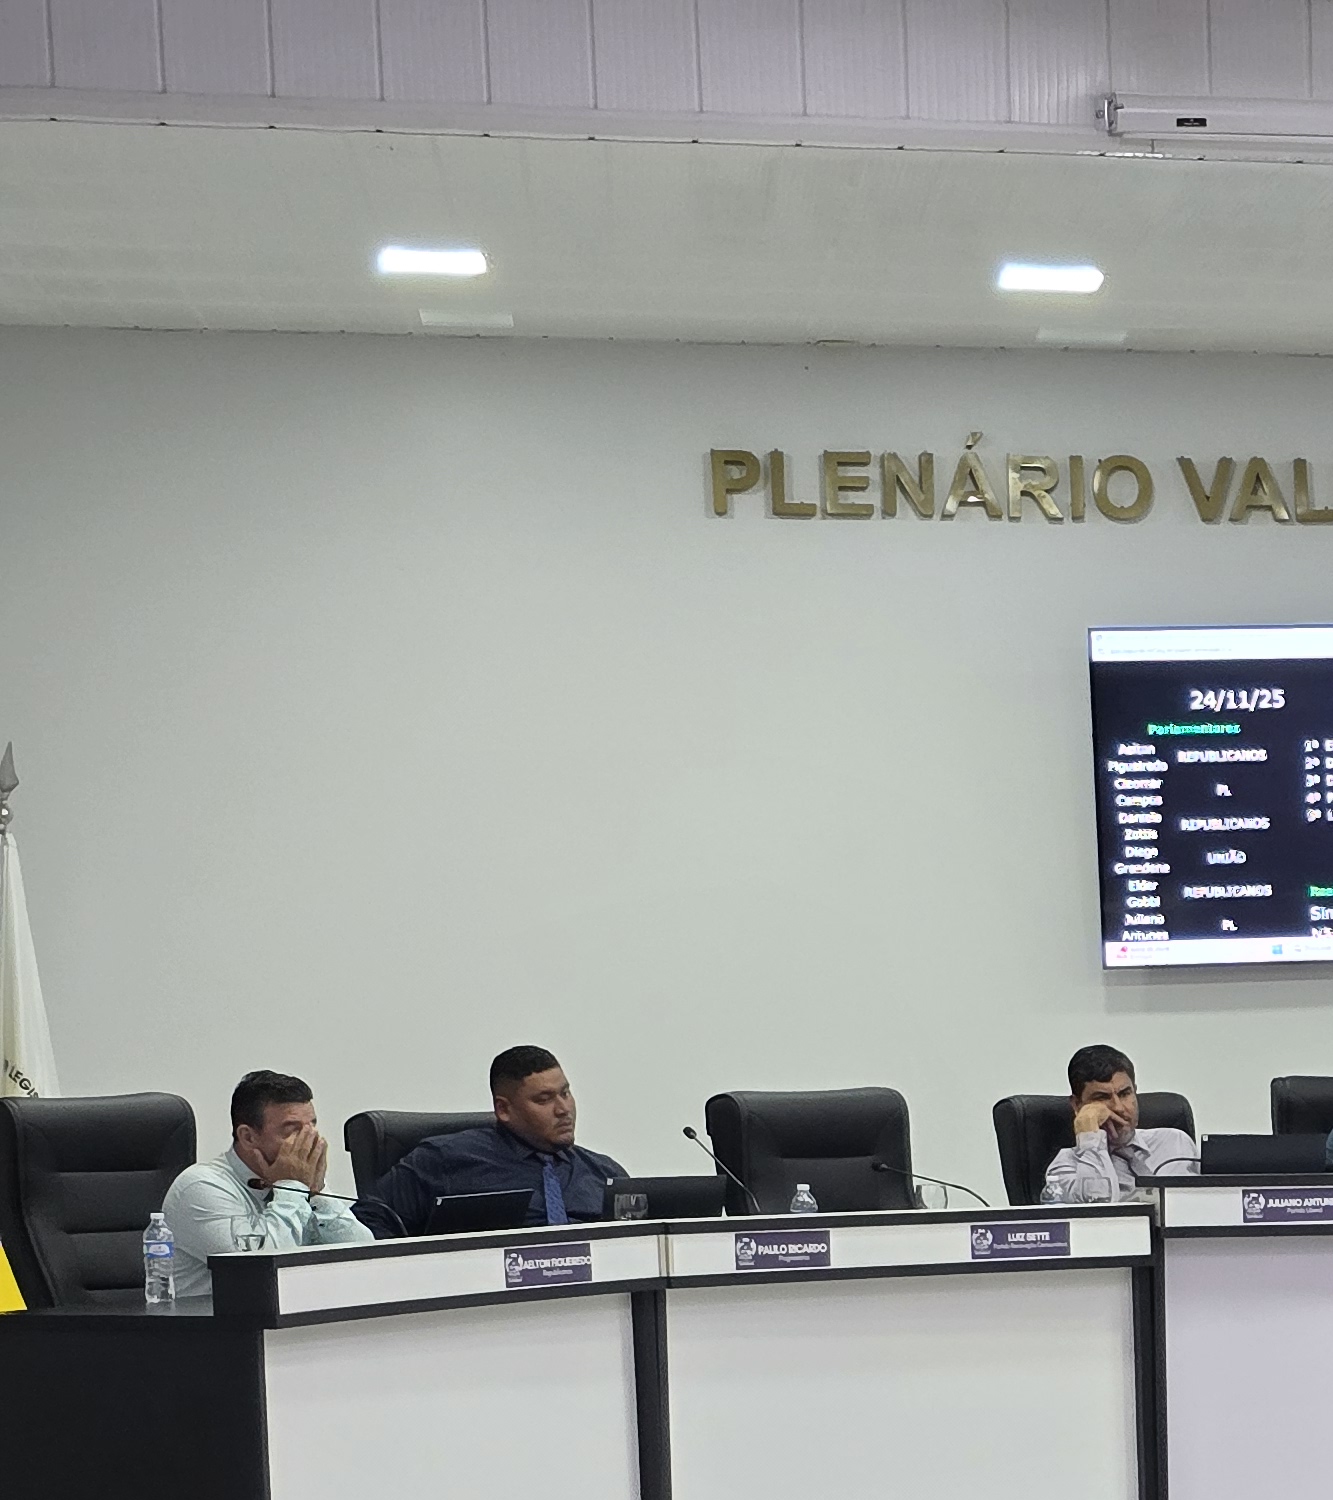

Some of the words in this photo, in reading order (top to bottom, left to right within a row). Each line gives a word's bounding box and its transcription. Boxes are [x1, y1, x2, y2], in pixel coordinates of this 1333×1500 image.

[710, 432, 1154, 522] PLENÁRIO
[1189, 688, 1286, 712] 24/11/25
[1177, 748, 1268, 762] REPUBLICANOS
[1215, 783, 1233, 797] PL
[1180, 816, 1271, 831] REPUBLICANOS
[1206, 849, 1247, 865] UNIÃO
[1183, 884, 1273, 899] REPUBLICANOS
[1220, 919, 1238, 931] PL
[1266, 1198, 1303, 1208] JULIANO
[1007, 1232, 1026, 1242] LUIZ
[1026, 1231, 1051, 1242] SETTE
[757, 1244, 788, 1255] PAULO
[788, 1243, 828, 1254] RICARDO
